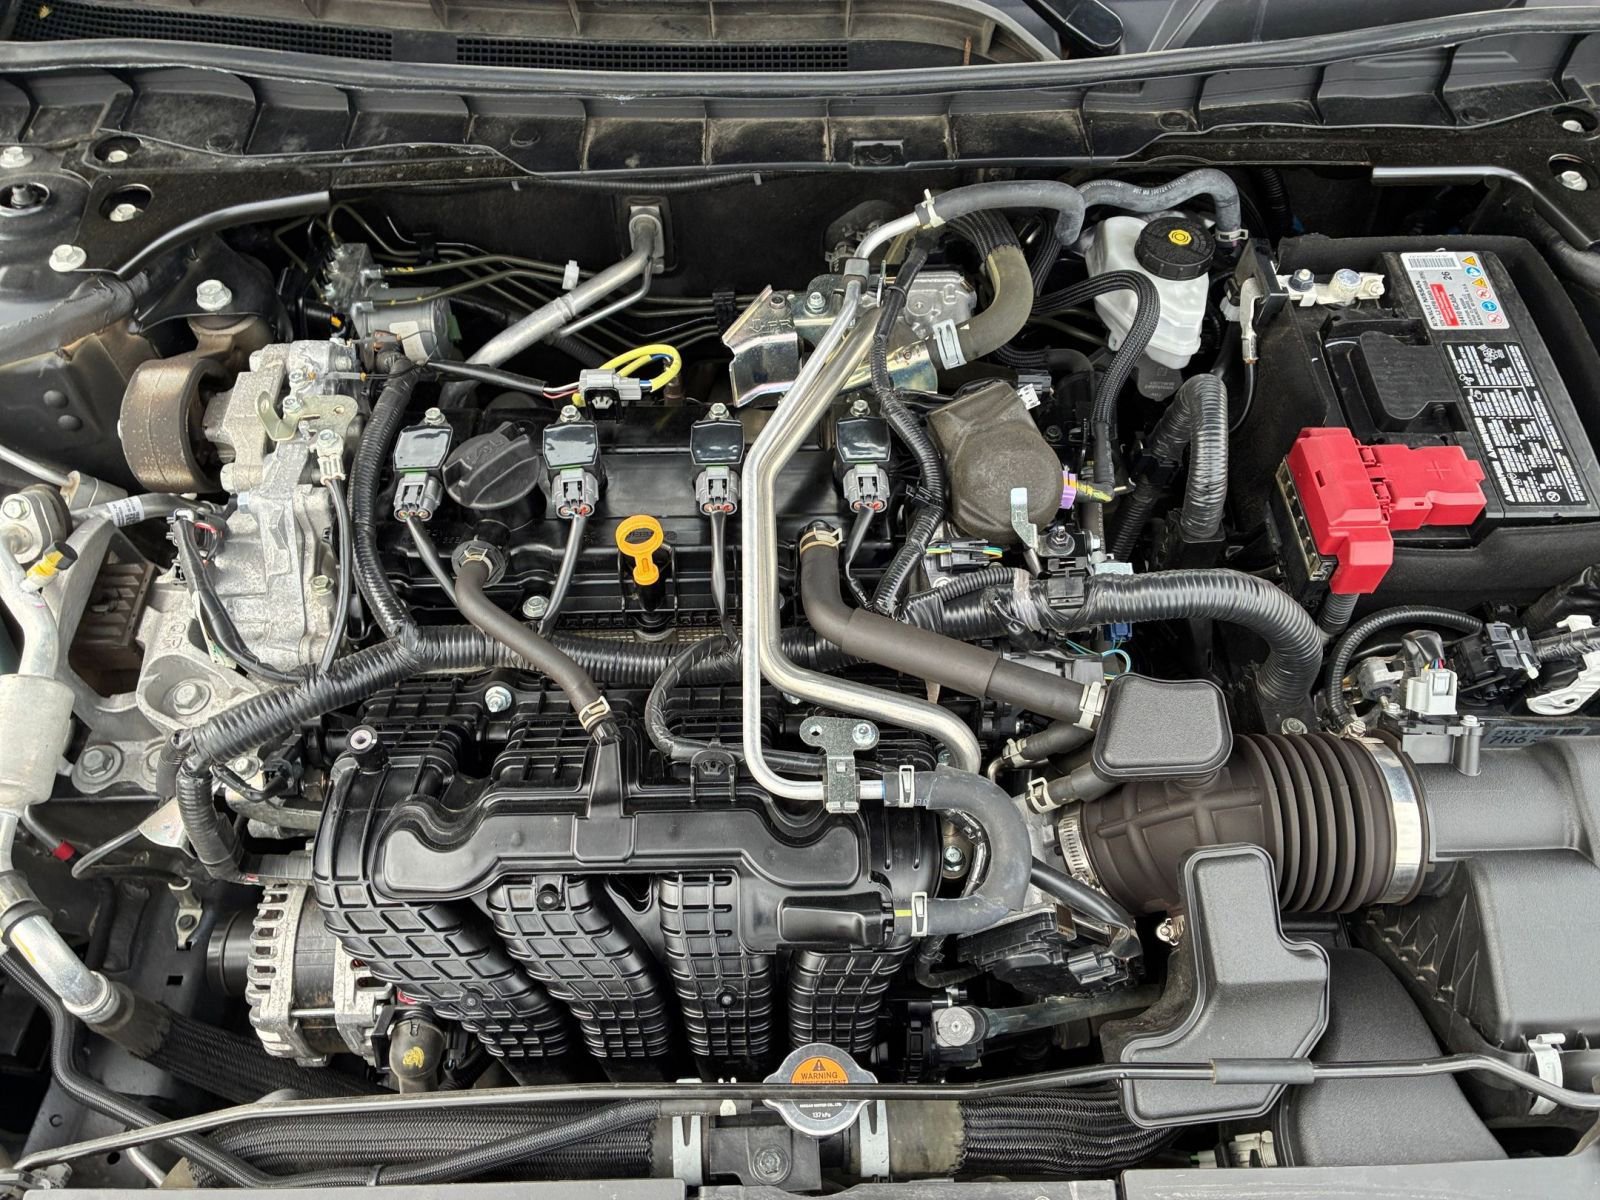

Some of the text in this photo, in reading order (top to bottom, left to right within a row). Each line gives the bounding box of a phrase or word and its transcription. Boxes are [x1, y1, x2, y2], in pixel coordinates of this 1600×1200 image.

[1441, 271, 1453, 281] 26
[1414, 280, 1428, 302] NISSAN
[801, 1071, 838, 1080] WARNING
